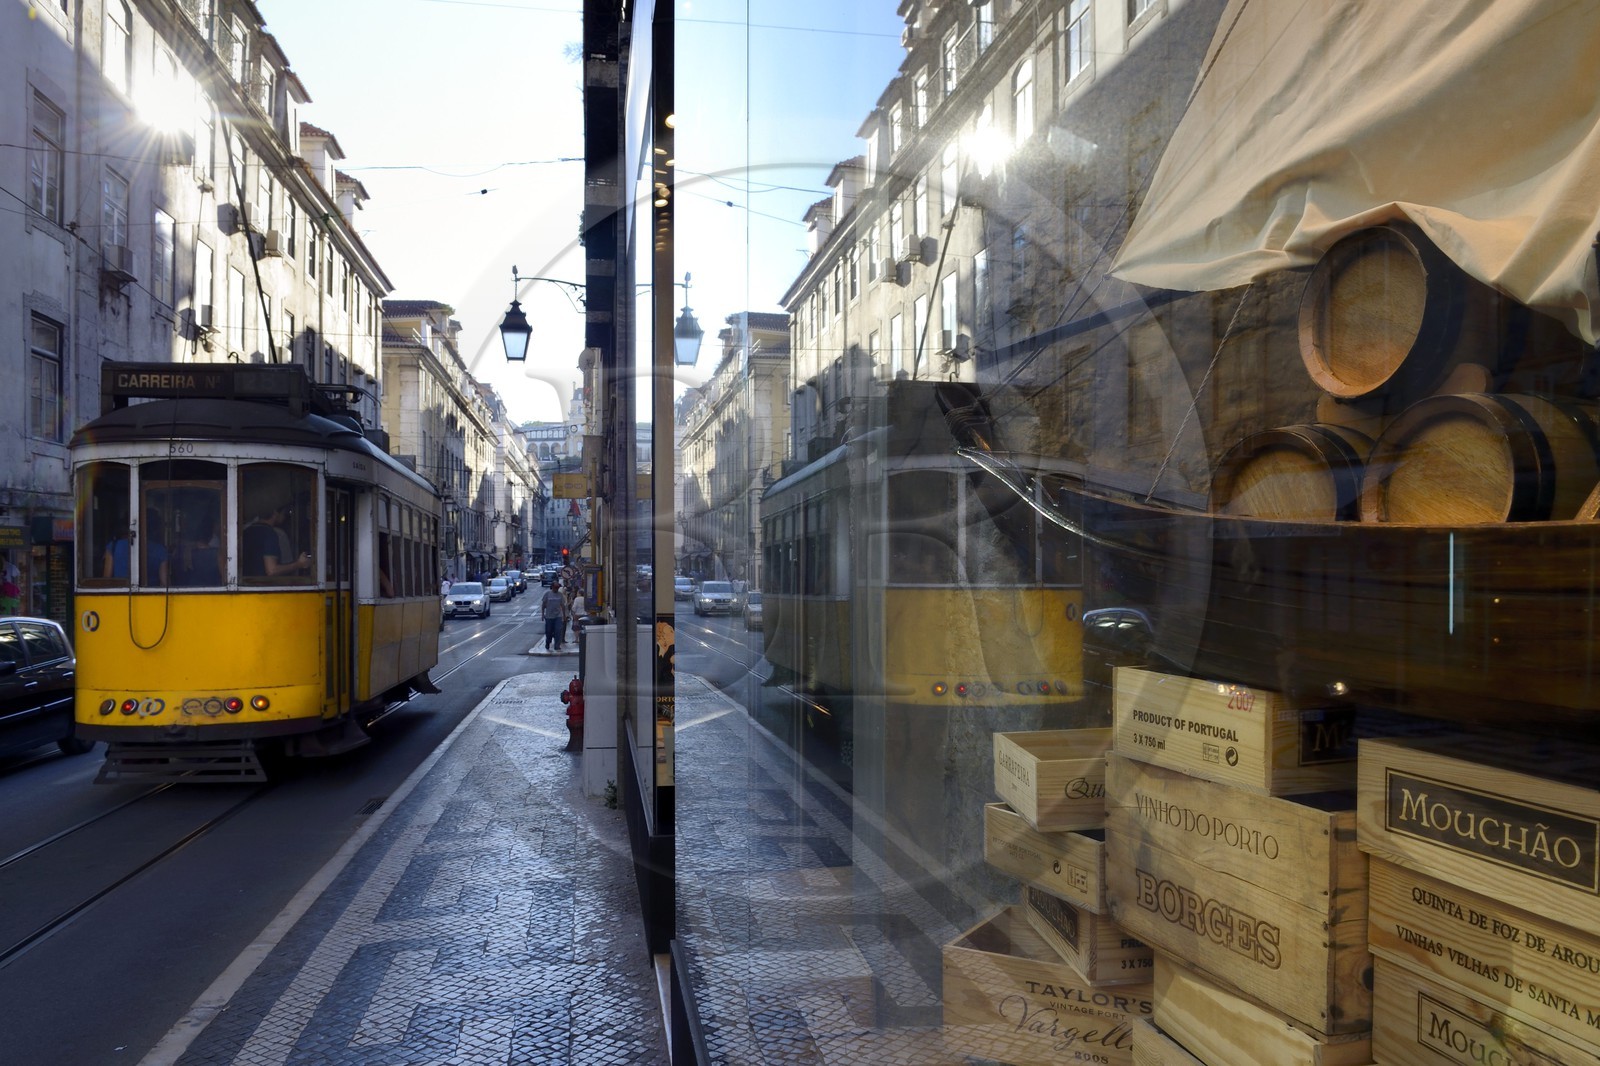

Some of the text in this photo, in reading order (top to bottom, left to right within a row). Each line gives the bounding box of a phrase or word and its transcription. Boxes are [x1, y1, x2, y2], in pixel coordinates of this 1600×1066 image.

[118, 374, 196, 389] CARREIRA
[1132, 709, 1239, 742] PRODUCT OF PORTUGAL
[1133, 733, 1166, 750] 3 X 750 ml
[1398, 788, 1581, 868] MOUCHÃO
[1135, 867, 1282, 971] BORGES
[1411, 887, 1465, 921] QUINTA
[1468, 909, 1488, 930] DE
[1492, 919, 1520, 944] FOZ
[1525, 931, 1546, 953] DE
[1121, 960, 1127, 969] 3
[1129, 959, 1135, 968] X
[1395, 924, 1444, 957] VINHAS
[1447, 947, 1499, 983] VELHAS
[1504, 973, 1523, 993] DE
[1528, 984, 1580, 1021] SANTA
[1025, 980, 1153, 1015] TAYLOR'S
[1049, 1001, 1126, 1021] VINTAGE PORT
[999, 994, 1133, 1051] Vargell
[1074, 1050, 1109, 1065] 2008
